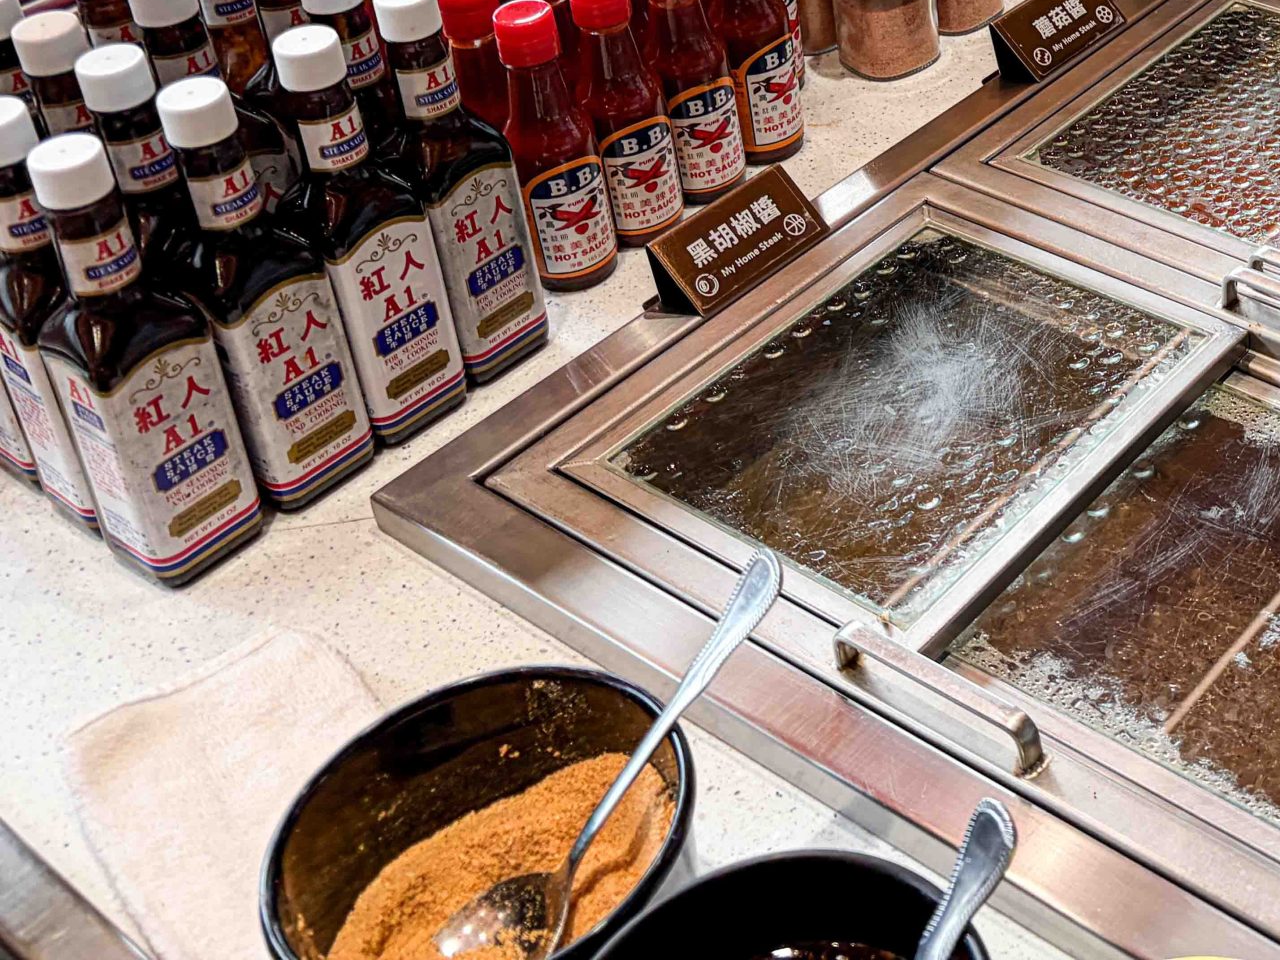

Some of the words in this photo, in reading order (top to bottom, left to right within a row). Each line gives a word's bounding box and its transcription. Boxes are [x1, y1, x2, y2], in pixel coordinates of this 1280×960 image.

[119, 25, 136, 42] A
[290, 8, 306, 26] A
[350, 37, 376, 62] A1
[1052, 42, 1064, 53] My
[1062, 31, 1081, 46] Home
[1079, 19, 1097, 35] Steak
[186, 50, 213, 76] A1
[425, 65, 451, 91] A1
[11, 70, 30, 93] A
[75, 104, 92, 126] A
[330, 115, 357, 143] A1
[764, 122, 785, 134] HOT
[786, 111, 802, 126] SAU
[690, 169, 713, 179] HOT
[715, 154, 741, 174] SAUCE
[222, 169, 250, 198] A1
[18, 198, 39, 221] A
[454, 195, 513, 243] 紅人
[624, 209, 648, 220] HOT
[650, 193, 678, 214] SAUCE
[96, 231, 127, 263] A1
[475, 229, 506, 264] A1
[686, 194, 782, 269] 黑胡椒醬
[475, 250, 514, 278] STEAK
[554, 252, 579, 263] HOT
[581, 235, 611, 257] SAUCE
[720, 264, 736, 278] My
[735, 246, 760, 268] Home
[759, 231, 784, 251] Steak
[359, 250, 425, 302] 紅人
[477, 257, 516, 287] SAUCE
[383, 285, 417, 323] A1
[476, 293, 489, 307] FOR
[490, 272, 527, 298] SEASONING
[479, 299, 493, 312] AND
[496, 281, 524, 303] COOKING
[256, 309, 328, 364] 紅人
[384, 306, 426, 338] STEAK
[386, 314, 428, 345] SAUCE
[488, 331, 501, 345] NET
[519, 314, 531, 325] OZ
[384, 353, 399, 368] FOR
[401, 328, 439, 357] SEASONING
[389, 358, 404, 372] AND
[406, 339, 438, 363] COOKING
[283, 346, 320, 386] A1
[67, 376, 95, 410] A1
[284, 367, 330, 400] STEAK
[286, 375, 332, 408] SAUCE
[400, 392, 414, 407] NET
[434, 373, 446, 386] OZ
[133, 375, 211, 434] 紅人
[285, 415, 301, 431] FOR
[304, 390, 345, 418] SEASONING
[291, 422, 306, 437] AND
[309, 400, 345, 424] COOKING
[162, 413, 203, 456] A1
[164, 436, 214, 471] STEAK
[166, 444, 216, 480] SAUCE
[301, 456, 317, 471] NET
[340, 434, 353, 447] OZ
[165, 488, 183, 504] FOR
[185, 459, 229, 490] SEASONING
[171, 493, 187, 507] AND
[190, 470, 228, 497] COOKING
[183, 529, 200, 545] NET
[224, 505, 238, 518] OZ
